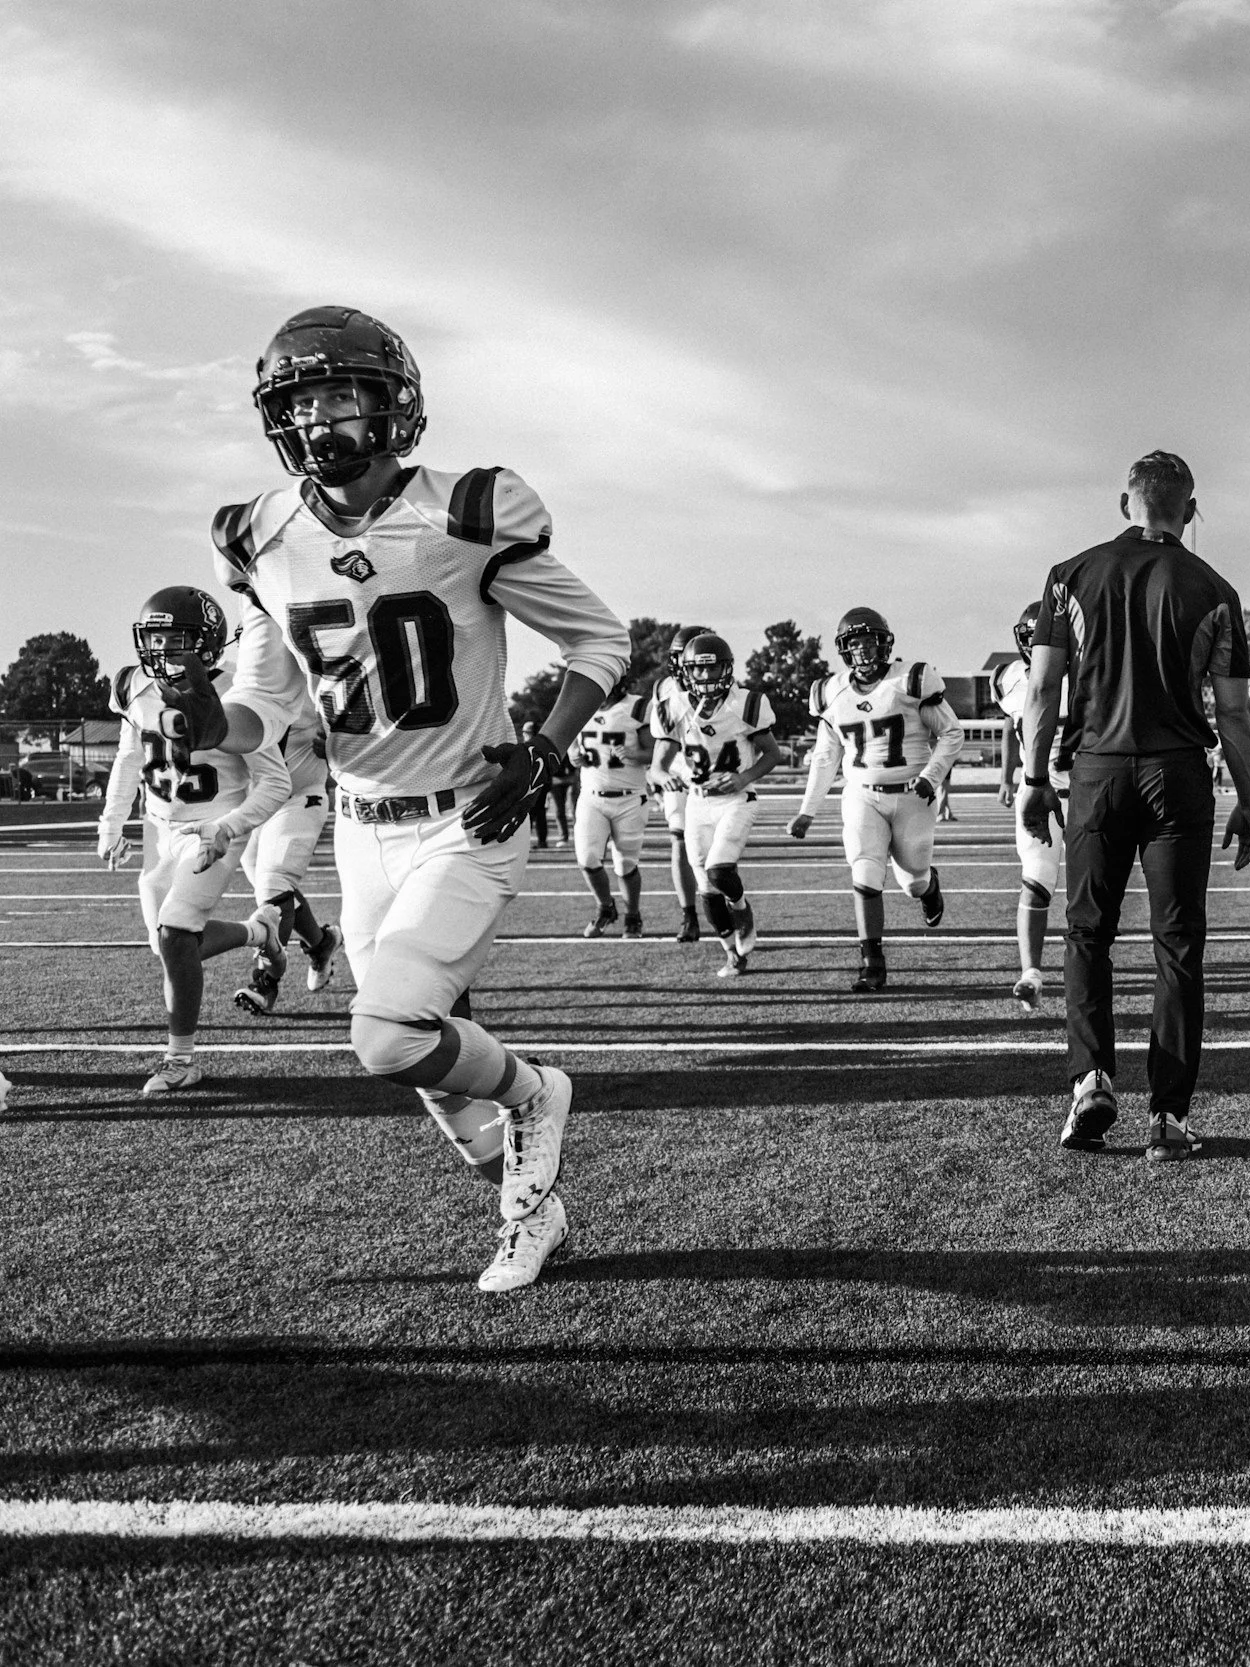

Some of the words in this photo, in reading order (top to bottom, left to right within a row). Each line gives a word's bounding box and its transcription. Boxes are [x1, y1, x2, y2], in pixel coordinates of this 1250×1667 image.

[286, 590, 460, 735] 50
[685, 740, 741, 785] 34
[839, 714, 907, 768] 77
